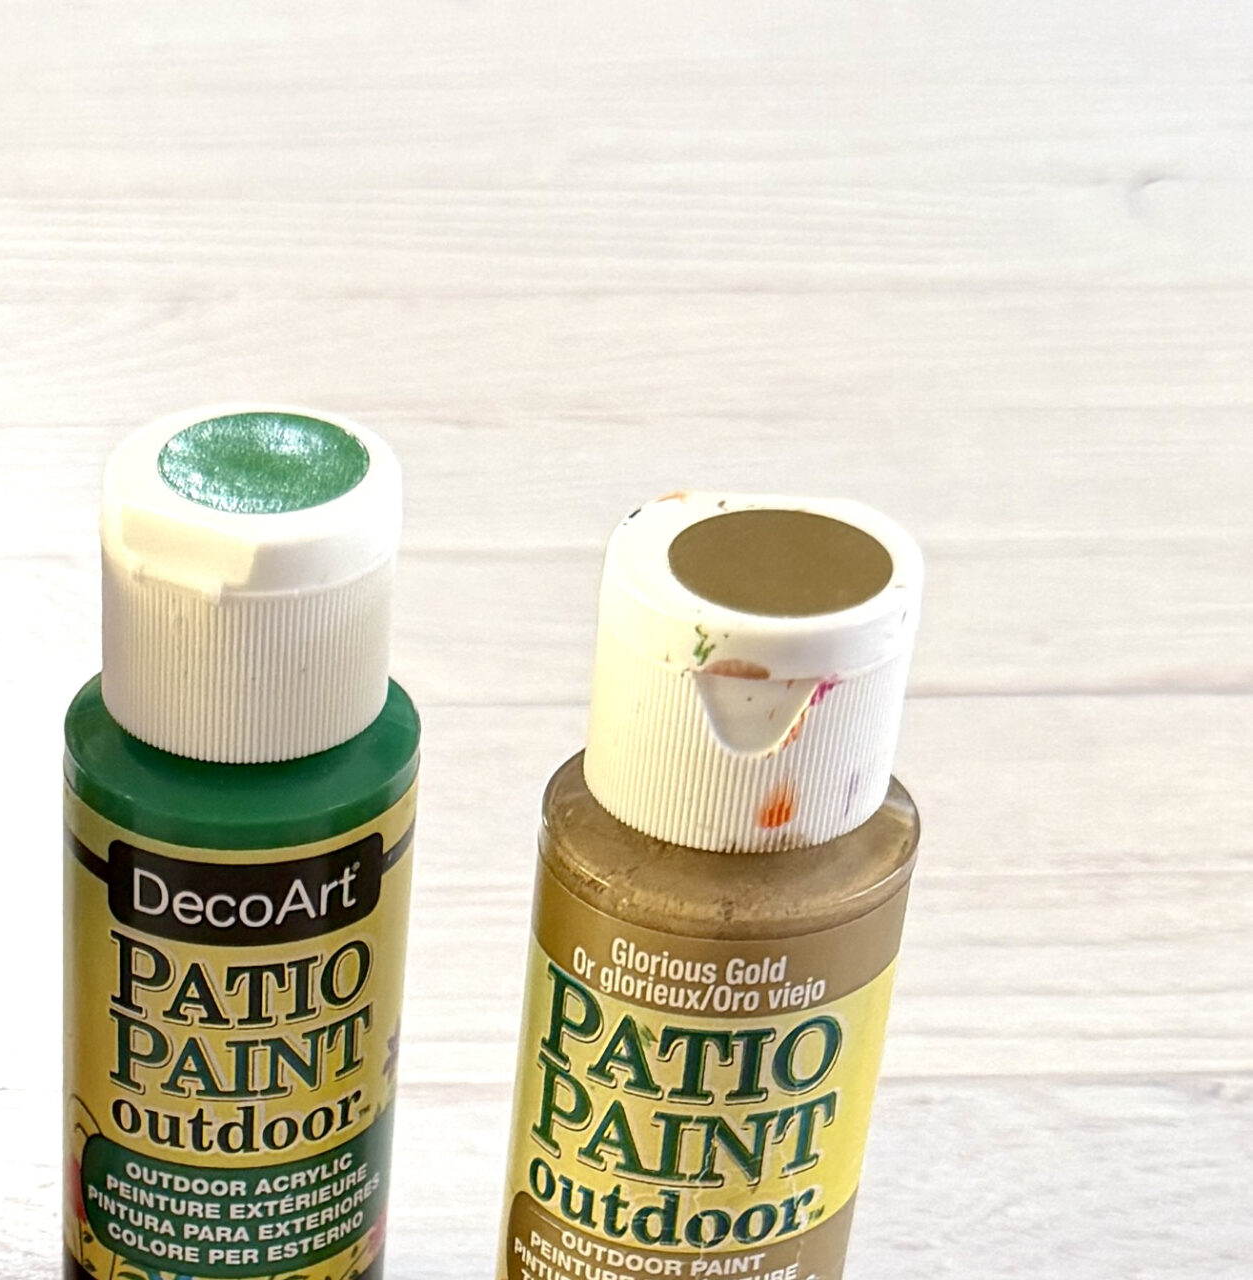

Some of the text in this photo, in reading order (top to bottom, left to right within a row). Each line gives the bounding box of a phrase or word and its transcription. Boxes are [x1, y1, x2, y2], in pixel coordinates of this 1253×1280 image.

[133, 862, 358, 928] DecoArt
[109, 929, 373, 1029] PATIO
[573, 945, 826, 1013] Or glorieux/Oro viejo
[611, 937, 788, 985] Glorious Gold
[109, 1003, 373, 1102] PAINT
[540, 965, 844, 1105] PATIO
[111, 1089, 363, 1154] outdoor
[530, 1051, 839, 1187] PAINT
[87, 1171, 380, 1243] PINTURA PARA EXTERIORES
[106, 1162, 368, 1220] PEINTURE EXTÉRIEURE
[125, 1152, 353, 1197] OUTDOOR ACRYLIC
[529, 1156, 816, 1249] outdoor
[107, 1210, 364, 1266] COLORE PER ESTERNO
[561, 1230, 766, 1277] OUTDOOR PAINT
